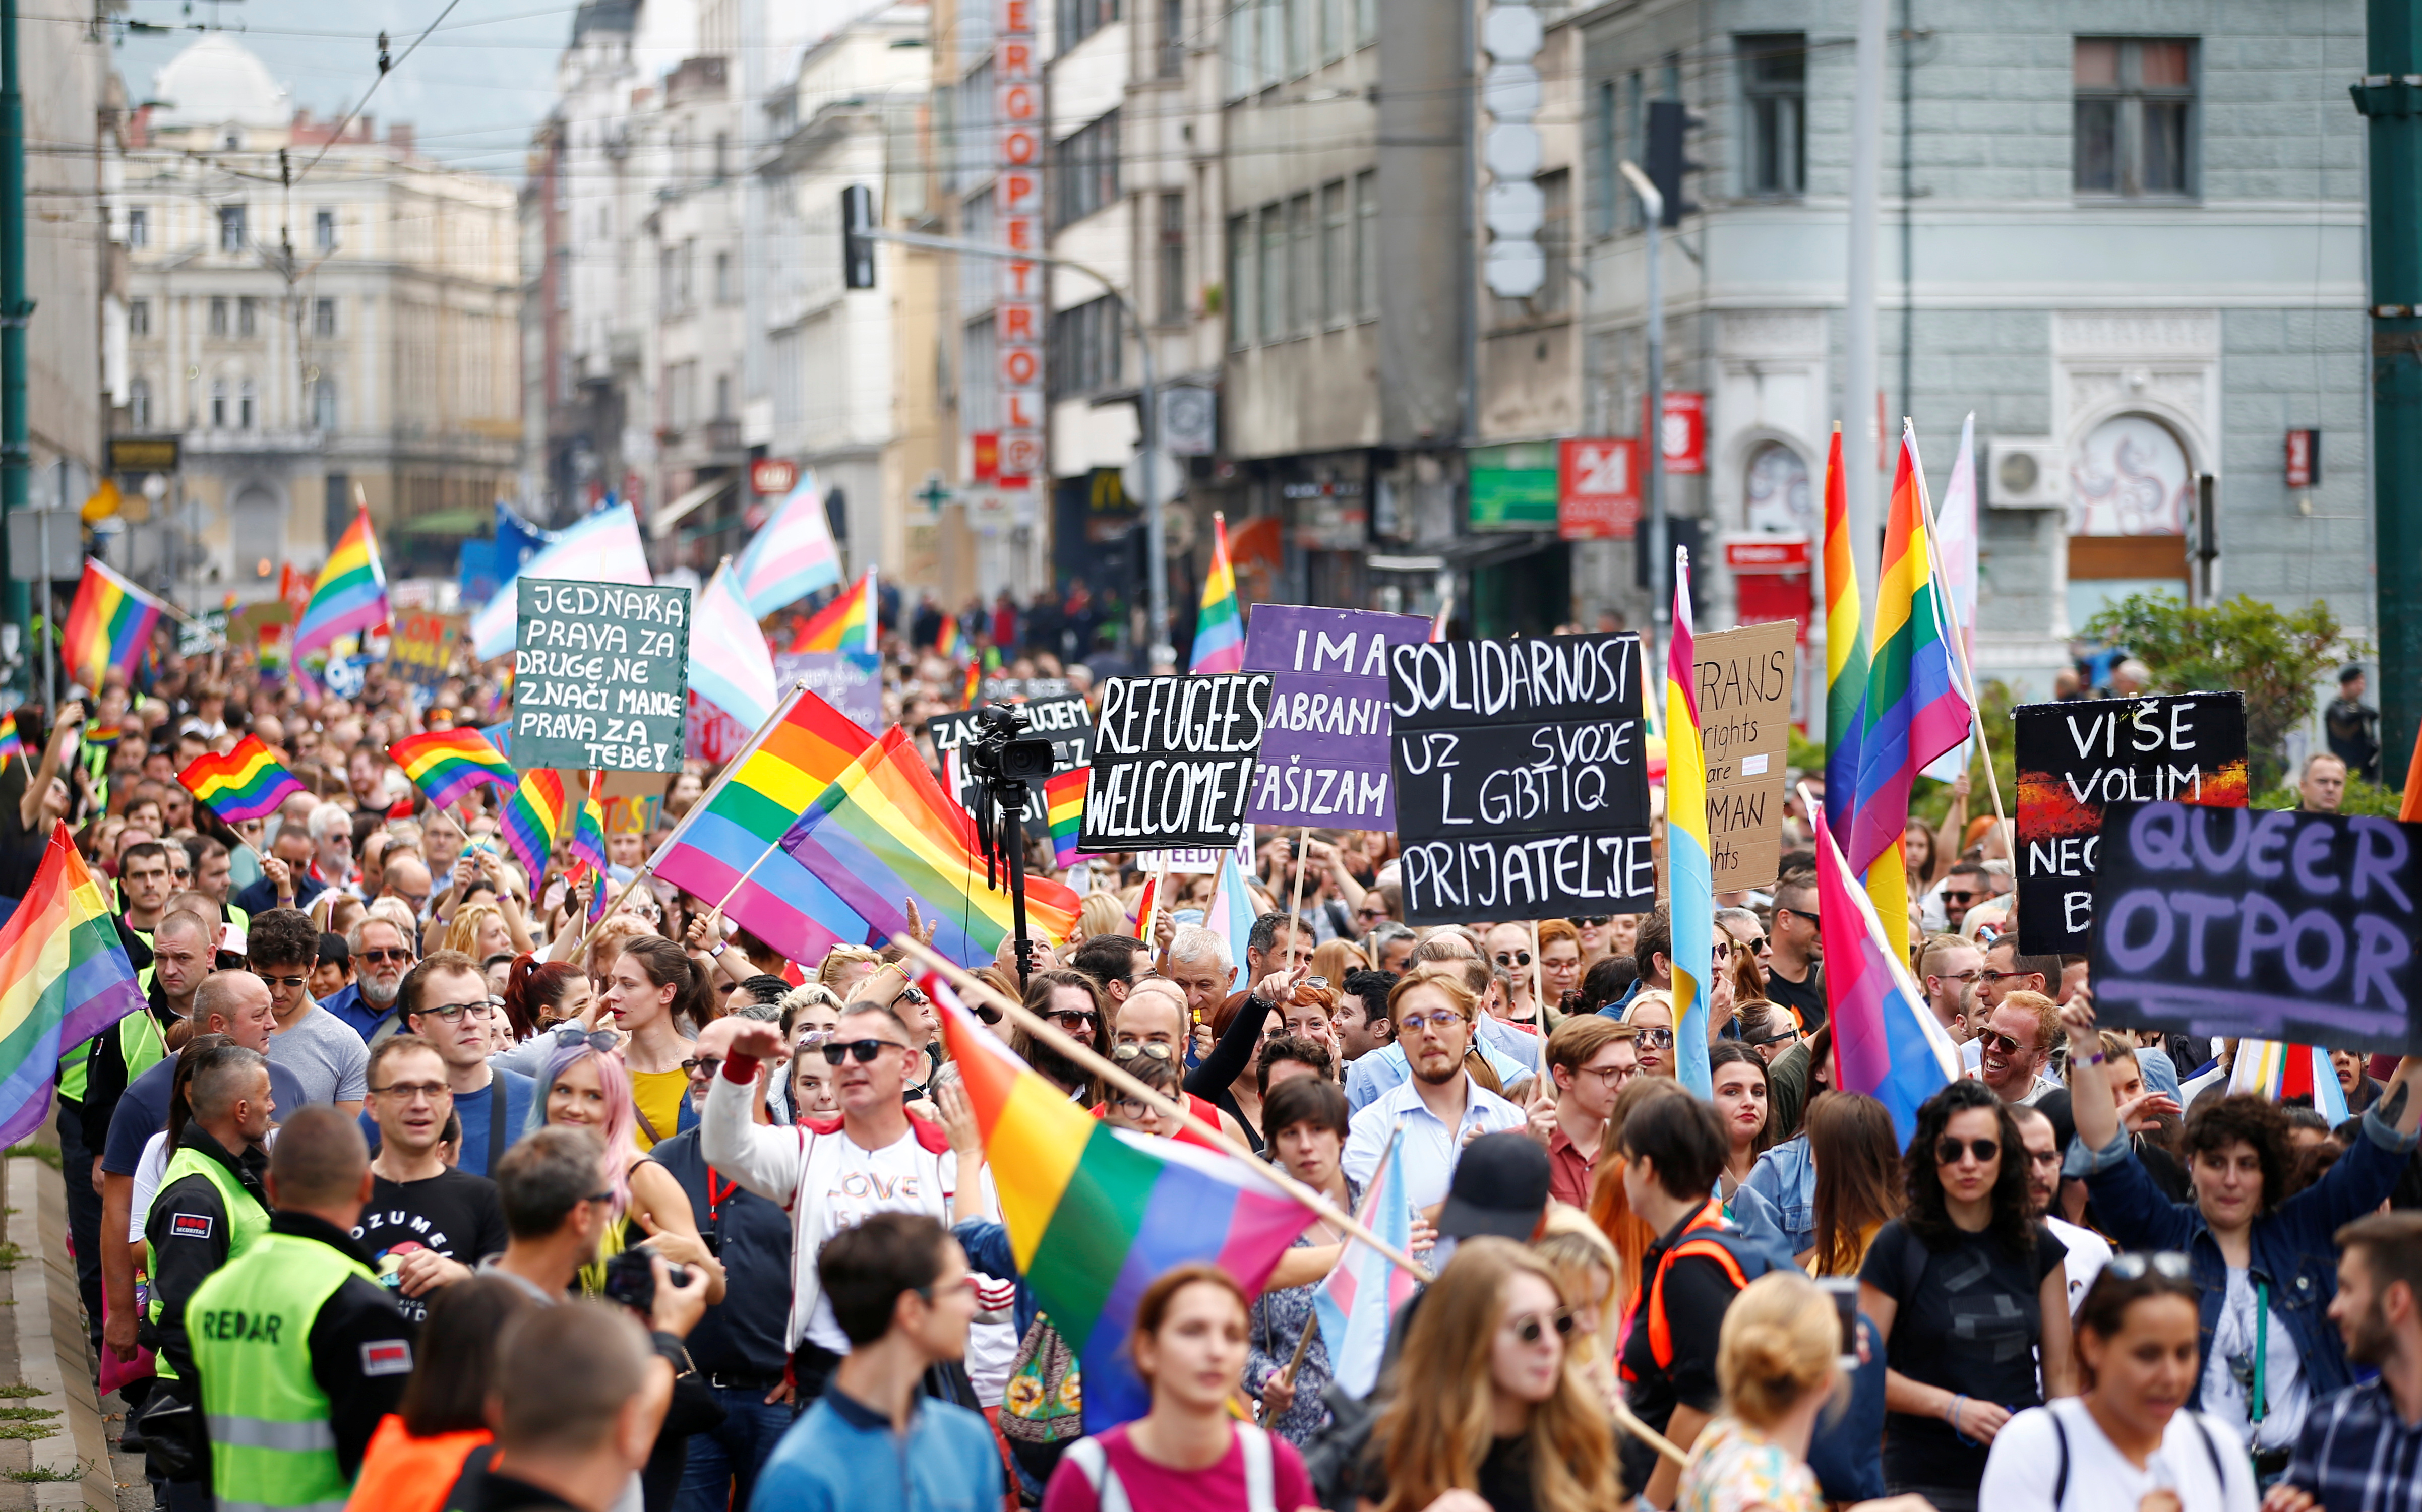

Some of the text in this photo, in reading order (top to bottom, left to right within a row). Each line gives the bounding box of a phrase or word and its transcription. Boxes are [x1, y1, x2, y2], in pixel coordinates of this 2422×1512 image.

[535, 586, 683, 627] JEDNAKA
[527, 619, 675, 658] PRAVA ZA
[1294, 629, 1387, 676] IMA
[1392, 636, 1640, 717] SOLIDARNOST
[1693, 650, 1784, 713] RANS
[520, 681, 682, 718] ZNAČI MANJE
[1096, 676, 1269, 754] REFUGEES
[1264, 692, 1392, 737] ABRANI
[519, 713, 648, 745] PRAVA ZA
[1402, 721, 1634, 775] UZ SVOJE
[1703, 714, 1758, 761] rights
[584, 743, 669, 772] TEBE!
[1706, 766, 1731, 783] are
[1086, 758, 1252, 837] WELCOME!
[2065, 764, 2200, 804] VOLIM
[1706, 792, 1766, 835] MAN
[1402, 835, 1653, 910] PRIJATELJE
[2129, 801, 2414, 913] QUEER
[2104, 889, 2411, 1013] OTPOR
[176, 1227, 206, 1235] SECURITAS
[833, 1210, 851, 1228] IS
[204, 1310, 282, 1345] REDAR
